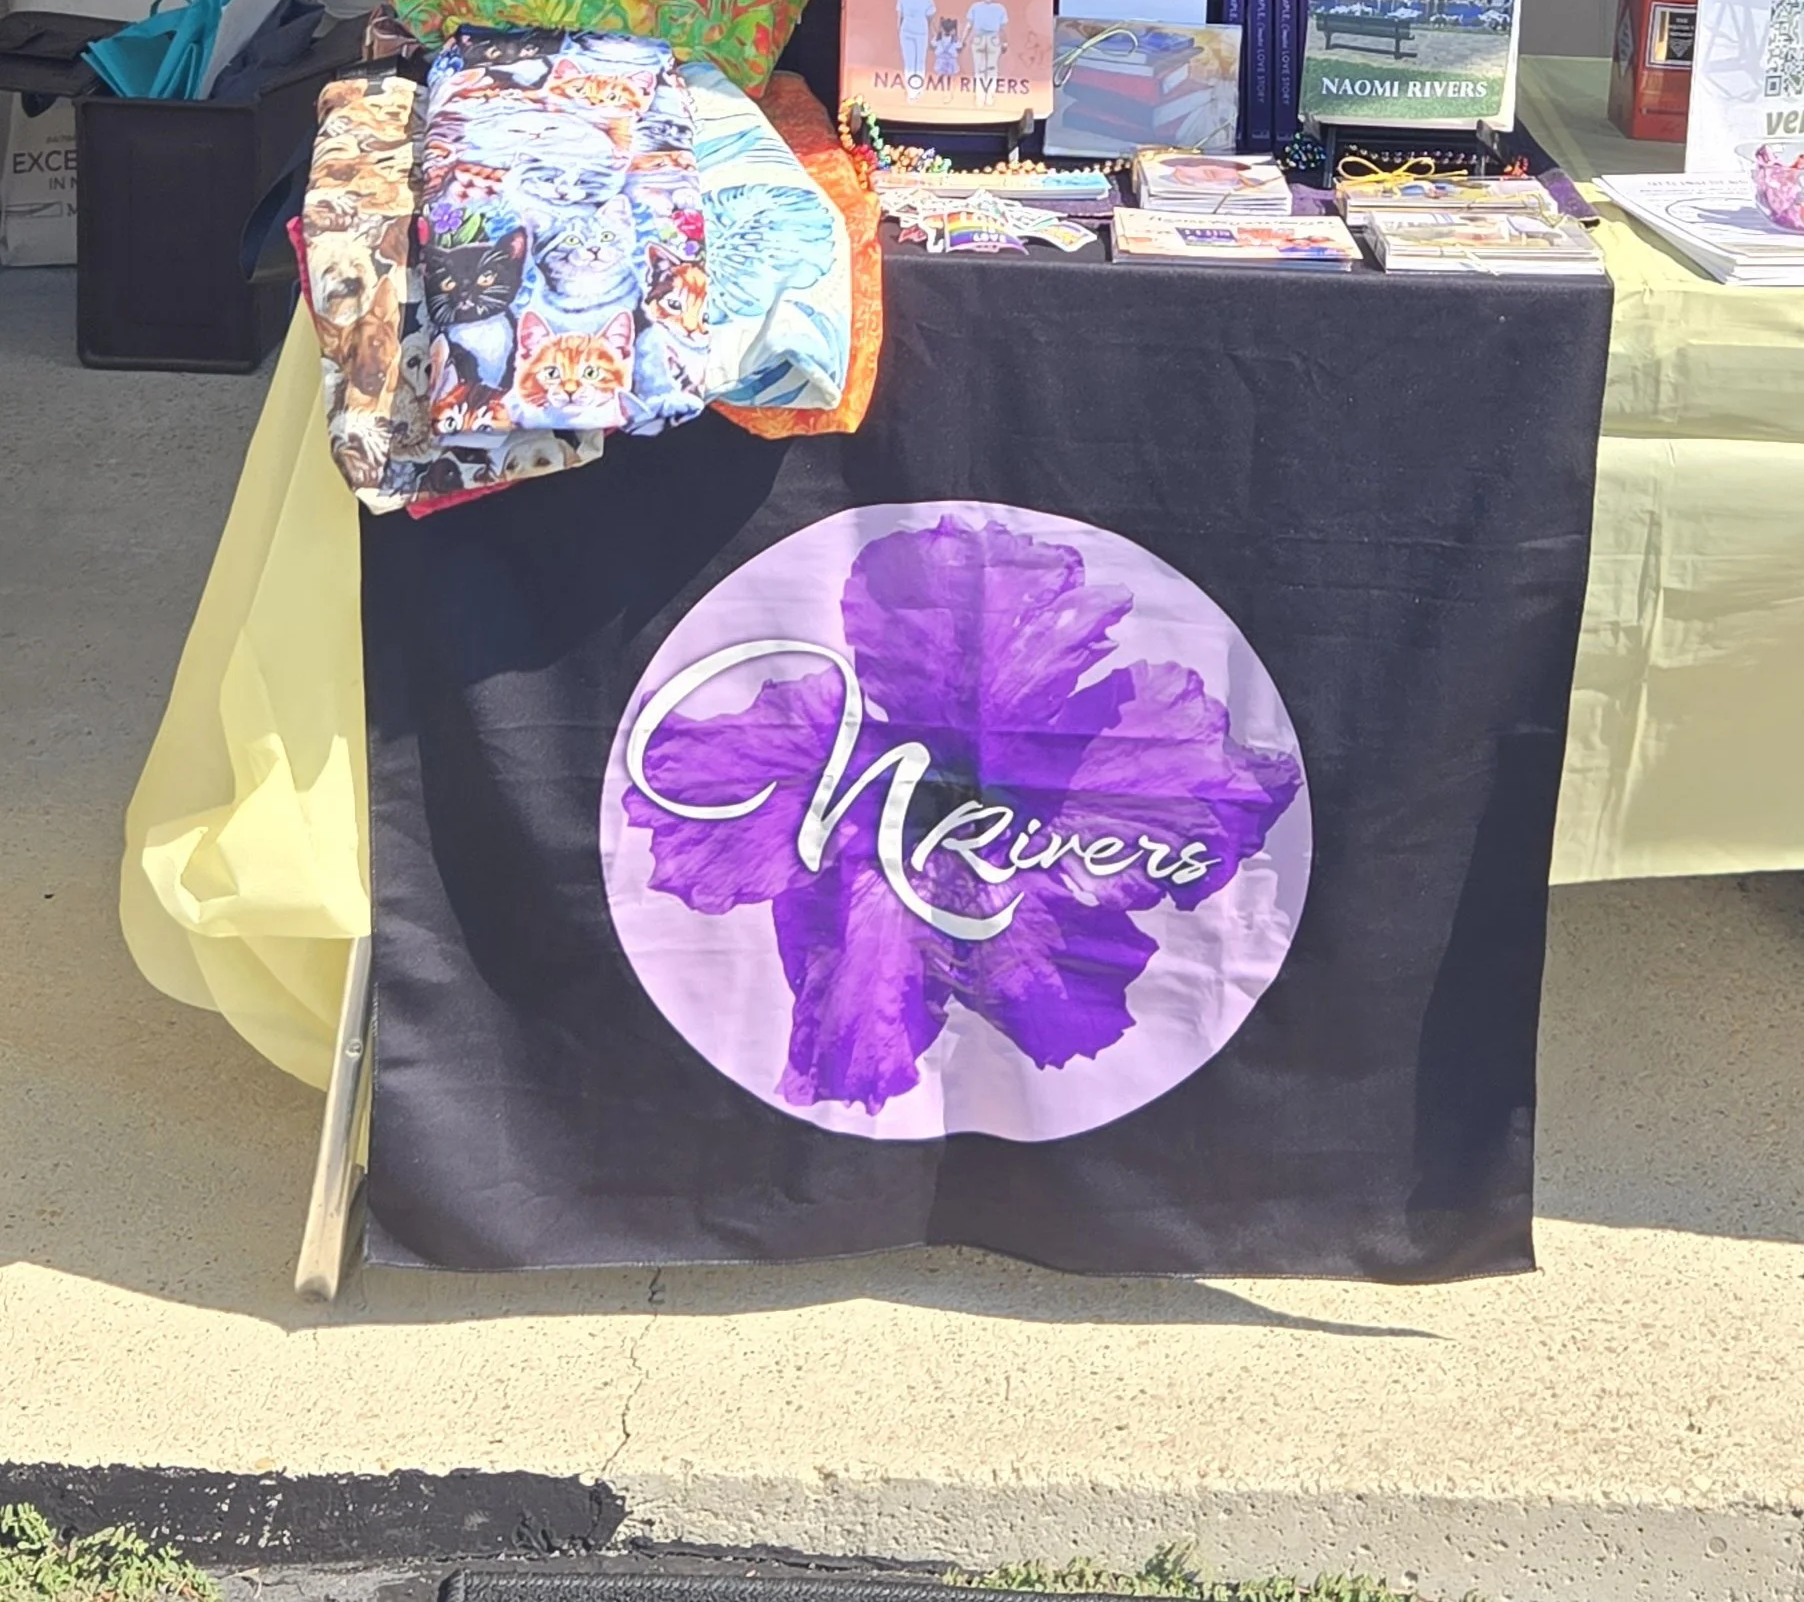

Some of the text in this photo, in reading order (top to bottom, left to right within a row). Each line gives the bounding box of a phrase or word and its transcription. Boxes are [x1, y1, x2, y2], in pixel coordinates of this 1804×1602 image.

[1257, 49, 1266, 73] LOVE
[1281, 50, 1290, 75] LOVE
[874, 72, 1030, 95] NAOMI RIVERS
[1256, 75, 1265, 104] STORY
[1281, 76, 1290, 105] STORY
[1321, 77, 1488, 98] NAOMI RIVERS
[49, 177, 65, 190] IN
